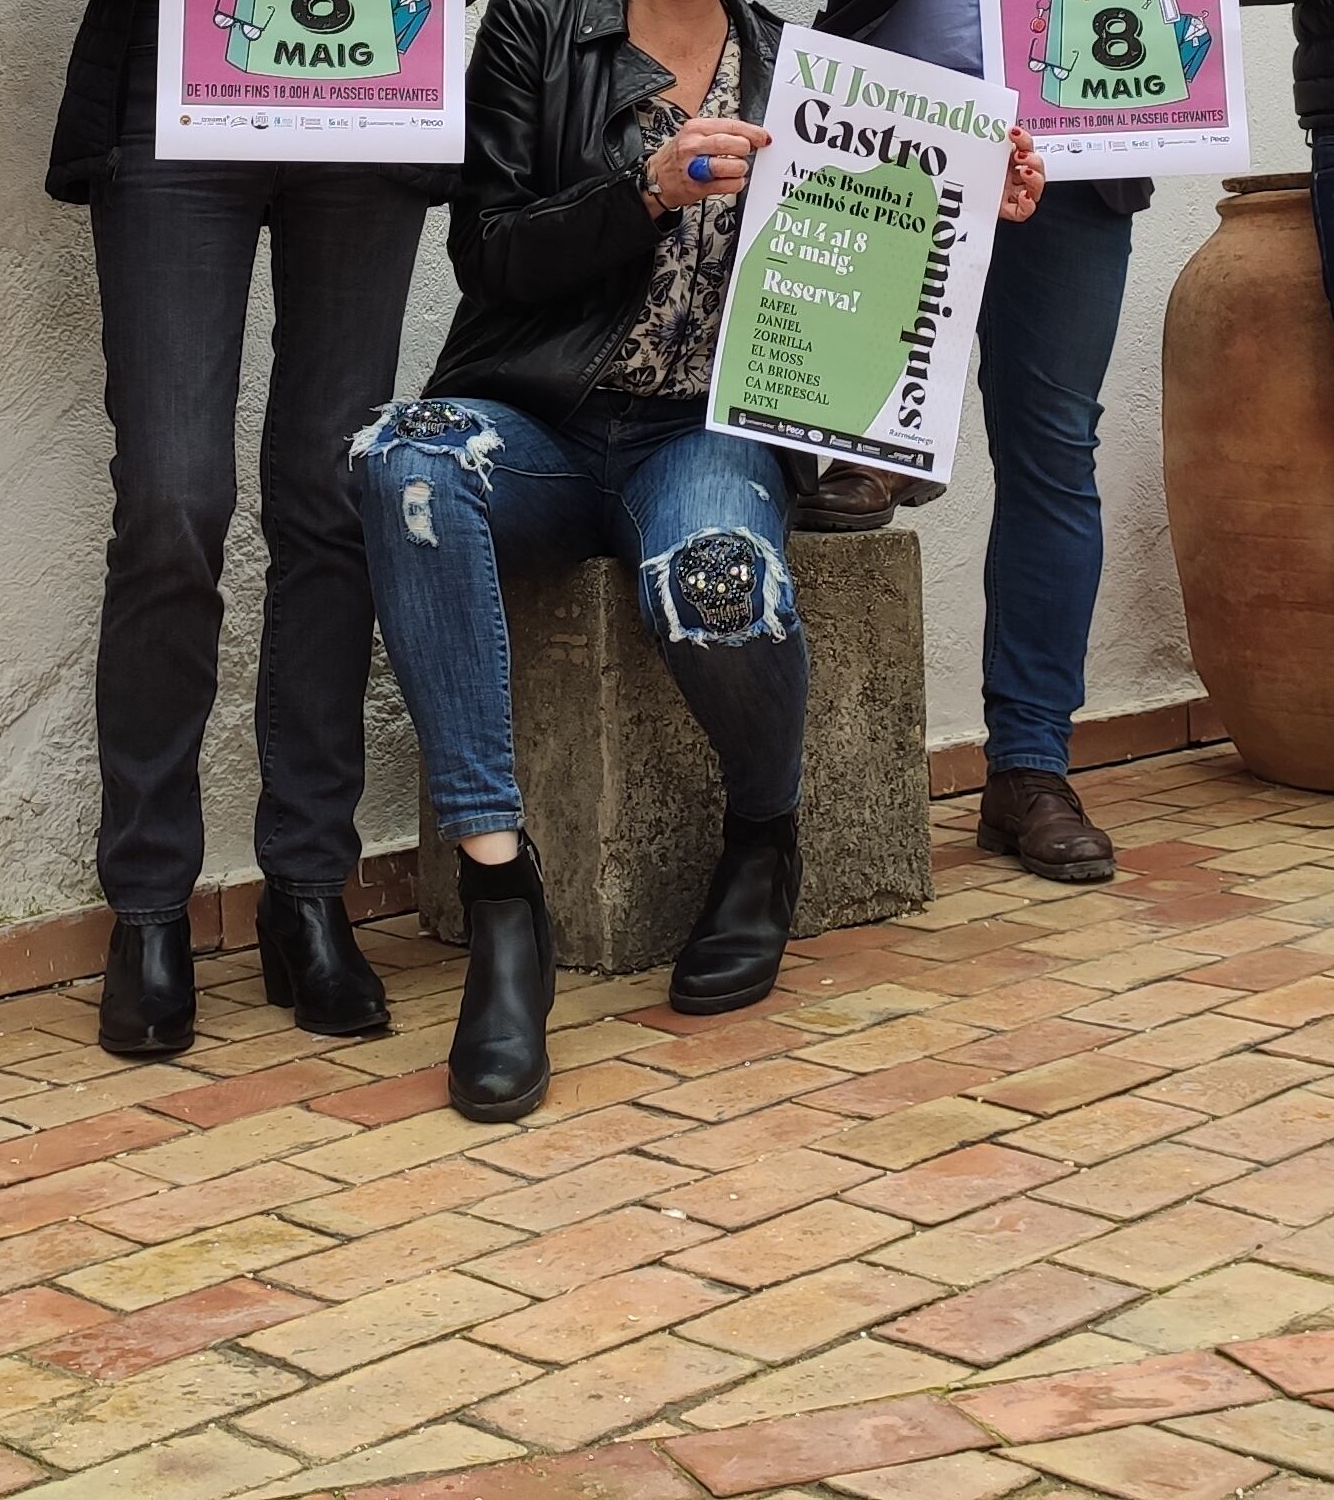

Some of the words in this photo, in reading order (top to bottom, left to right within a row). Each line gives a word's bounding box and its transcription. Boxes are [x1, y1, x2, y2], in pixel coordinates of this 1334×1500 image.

[1091, 8, 1146, 69] 8
[274, 40, 374, 68] MAIG
[187, 84, 201, 97] DE
[245, 85, 269, 98] FINS
[313, 85, 326, 99] AL
[329, 86, 374, 100] PASSEIG
[378, 87, 438, 101] CERVANTES
[785, 50, 843, 96] XI
[843, 64, 1008, 144] Jornades
[1081, 74, 1166, 99] MAIG
[1060, 116, 1080, 128] FINS
[1117, 114, 1128, 126] AL
[1130, 112, 1168, 125] PASSEIG
[1171, 110, 1224, 123] CERVANTES
[794, 98, 946, 176] Gastro
[784, 161, 836, 187] Arròs
[839, 174, 901, 206] Bomba
[905, 191, 913, 208] i
[781, 181, 845, 212] Bombó
[849, 200, 869, 219] de
[873, 205, 925, 233] PEGO
[773, 210, 811, 238] Del
[813, 222, 827, 242] 4
[830, 229, 851, 249] al
[853, 232, 867, 252] 8
[769, 233, 794, 256] de
[798, 245, 854, 275] maig.
[760, 268, 861, 313] Reserva!
[759, 296, 797, 315] RAFEL
[898, 180, 967, 430] nòmiques
[756, 312, 801, 333] DANIEL
[753, 328, 812, 352] ZORRILLA
[750, 344, 765, 357] EL
[769, 348, 804, 366] MOSS
[748, 360, 763, 373] CA
[767, 364, 820, 386] BRIONES
[742, 391, 778, 409] PATXI
[745, 376, 761, 389] CA
[764, 380, 829, 405] MERESCAL
